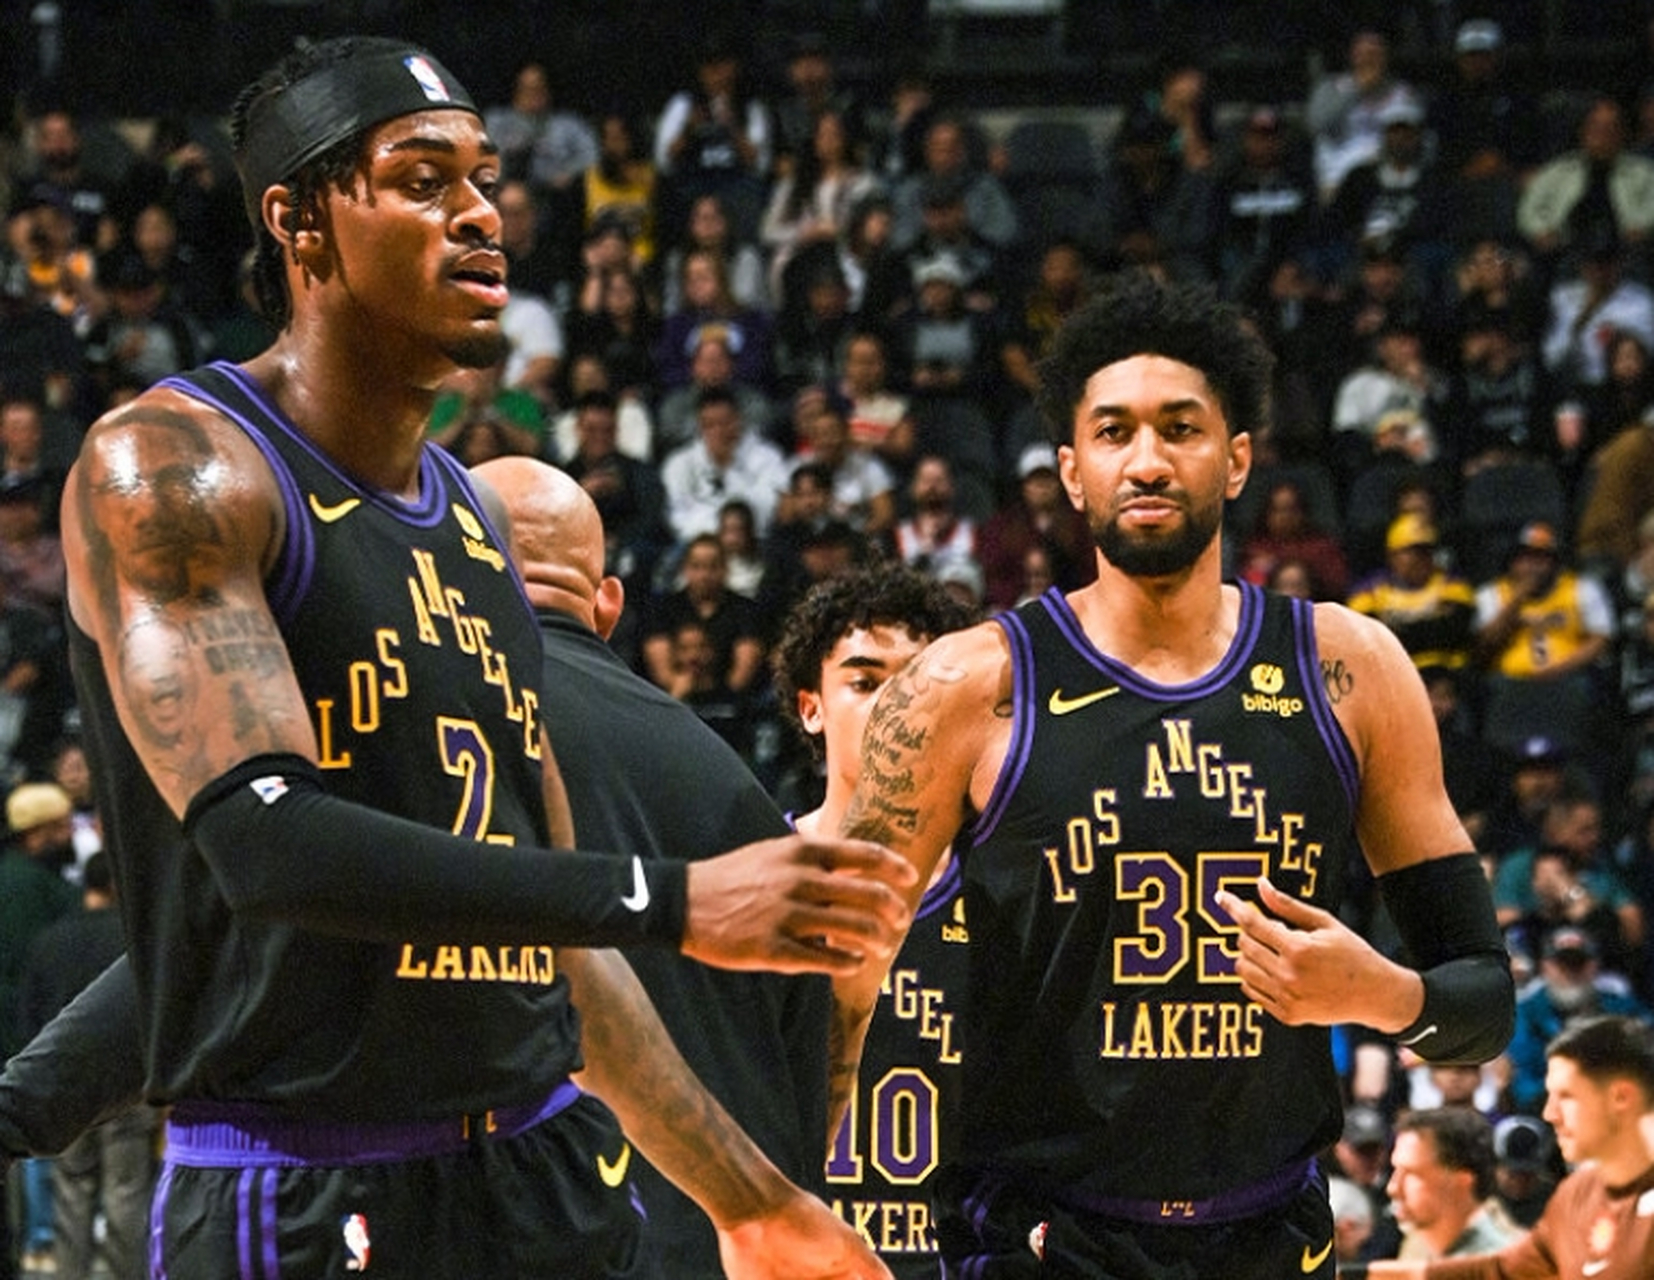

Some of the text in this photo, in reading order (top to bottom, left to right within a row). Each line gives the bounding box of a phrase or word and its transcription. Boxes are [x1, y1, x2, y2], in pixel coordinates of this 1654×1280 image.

[316, 627, 409, 770] LOS
[1241, 693, 1304, 717] bibigo
[1044, 718, 1324, 903] LOS ANGELES
[1113, 852, 1271, 984] 35
[880, 969, 962, 1064] GEL
[1100, 1001, 1264, 1059] LAKERS
